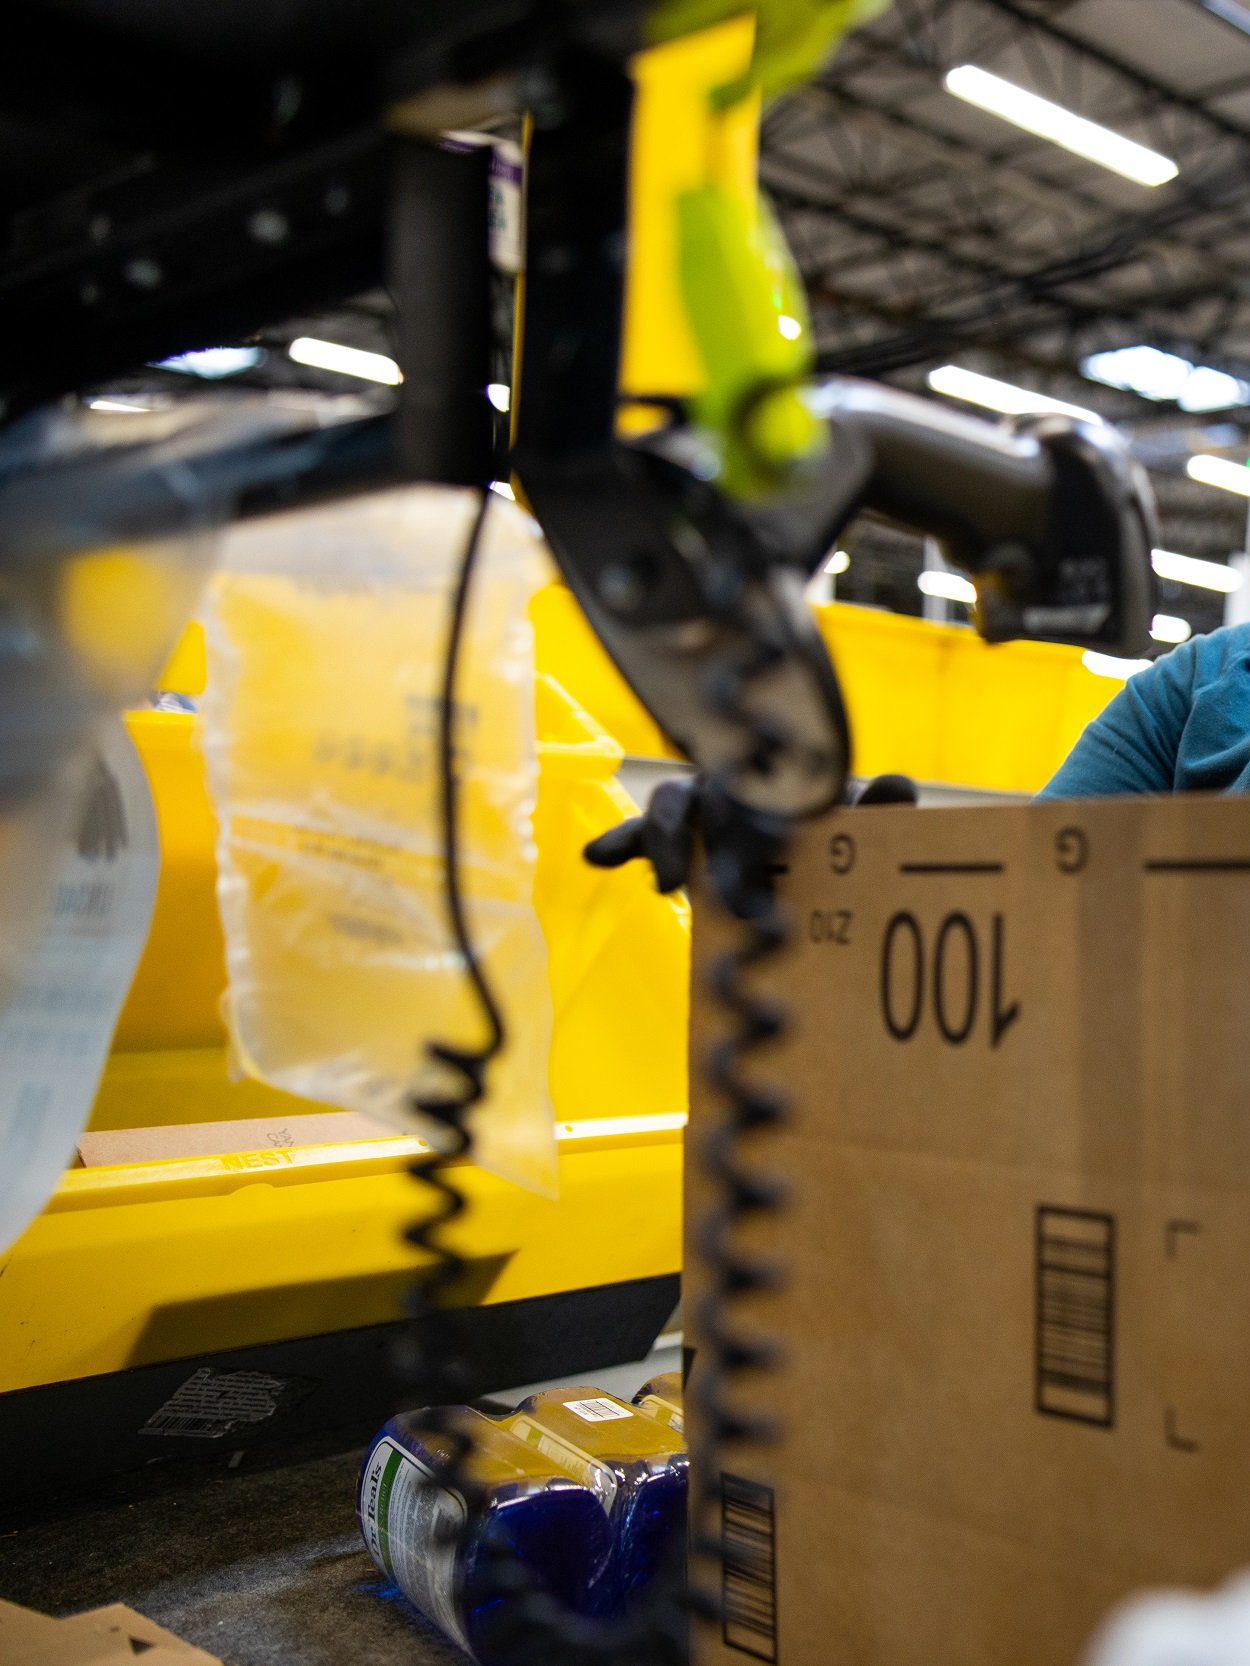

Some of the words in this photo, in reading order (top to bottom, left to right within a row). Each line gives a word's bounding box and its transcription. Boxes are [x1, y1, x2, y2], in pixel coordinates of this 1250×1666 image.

[829, 833, 856, 875] G
[1055, 825, 1089, 875] G
[881, 908, 1021, 1049] 100
[221, 1148, 294, 1171] NEST
[367, 1462, 382, 1523] Teal's
